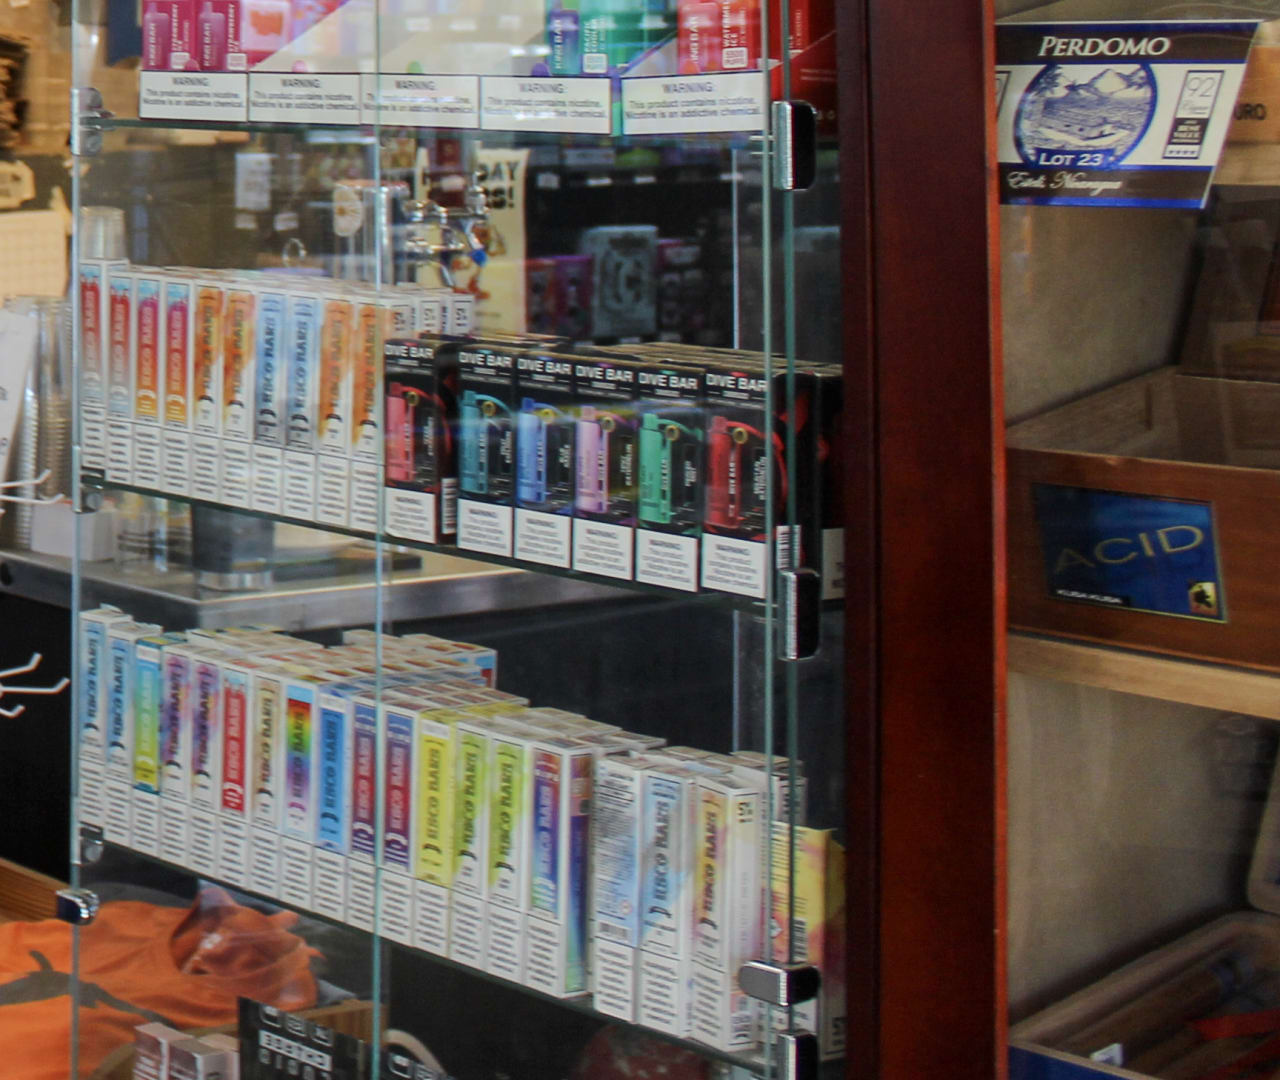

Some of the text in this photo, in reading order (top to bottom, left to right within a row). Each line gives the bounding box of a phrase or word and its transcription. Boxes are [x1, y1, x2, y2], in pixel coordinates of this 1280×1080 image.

[1038, 36, 1171, 58] PERDOMO
[1186, 75, 1215, 98] 92
[1040, 151, 1104, 167] LOT 23
[385, 343, 434, 360] DIVE BAR
[459, 351, 512, 368] DIVE BAR
[517, 357, 572, 376] DIVE BAR
[575, 365, 633, 382] DIVE BAR
[639, 372, 698, 390] DIVE BAR
[705, 372, 767, 392] DIVE BAR
[1054, 524, 1205, 575] ACID
